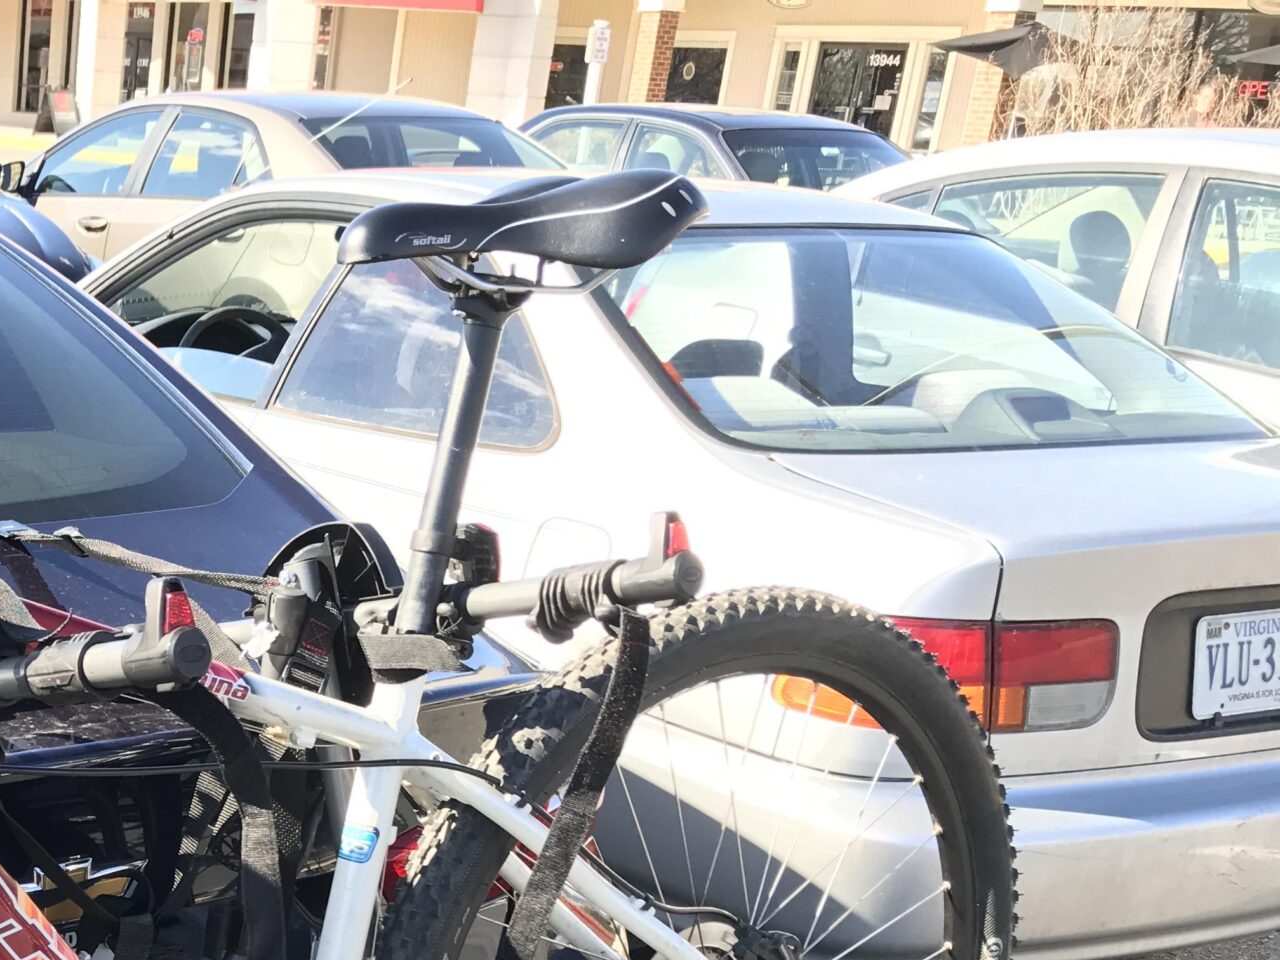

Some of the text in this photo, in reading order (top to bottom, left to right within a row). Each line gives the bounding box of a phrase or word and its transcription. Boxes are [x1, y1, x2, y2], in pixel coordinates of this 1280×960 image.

[869, 54, 901, 67] 13944
[1238, 81, 1269, 98] OPE
[1206, 626, 1222, 639] MAR
[1234, 619, 1280, 638] VIRGIN
[1206, 637, 1280, 691] VLU-3
